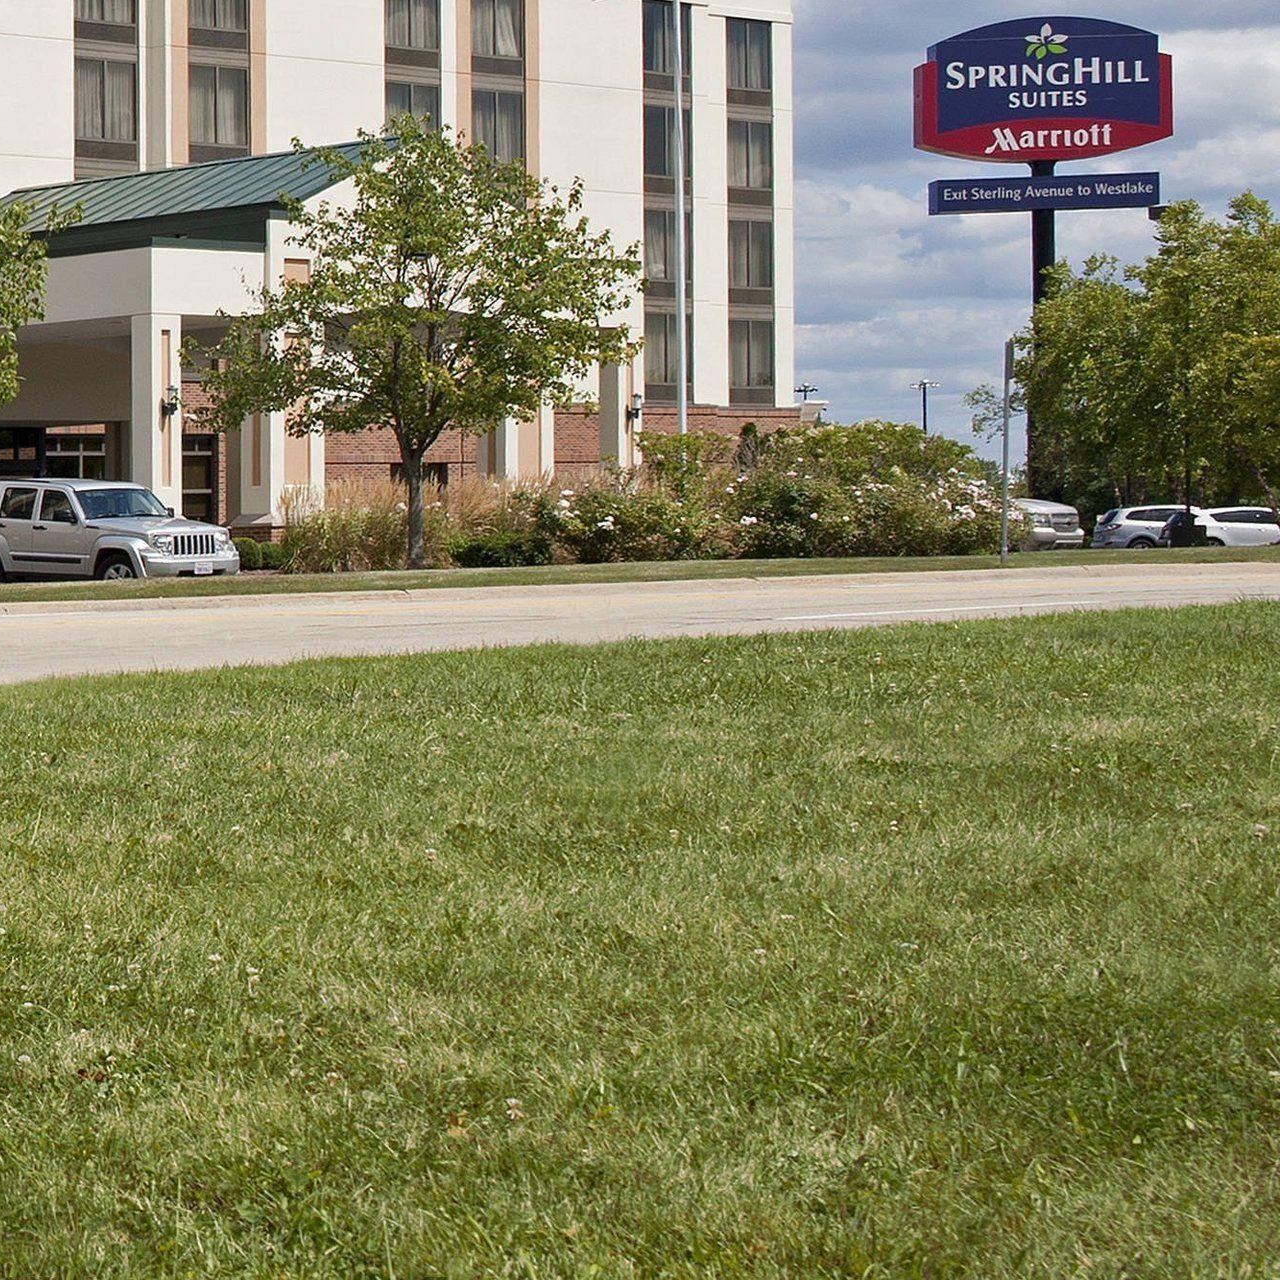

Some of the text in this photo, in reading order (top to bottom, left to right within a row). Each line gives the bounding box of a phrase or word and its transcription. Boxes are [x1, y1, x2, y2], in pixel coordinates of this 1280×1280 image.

[1008, 89, 1088, 109] SUITES
[984, 123, 1112, 154] Marriott
[943, 181, 1154, 202] Exit Sterling Avenue to Westlake
